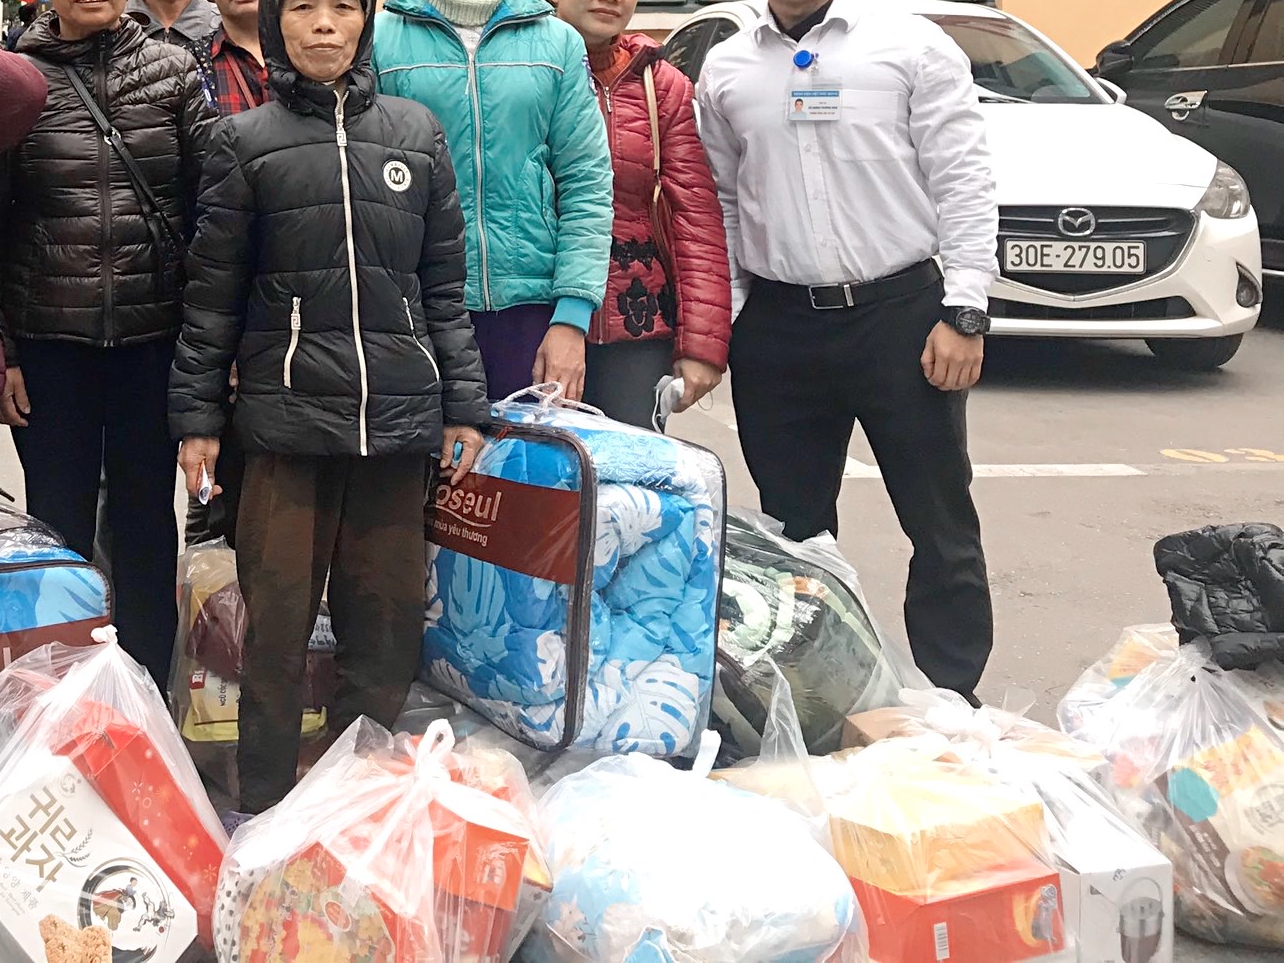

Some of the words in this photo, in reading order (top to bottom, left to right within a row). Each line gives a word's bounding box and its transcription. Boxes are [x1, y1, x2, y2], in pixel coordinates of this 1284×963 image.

[1010, 243, 1141, 270] 30E-279.05
[435, 484, 502, 522] oseul
[28, 785, 78, 852] 귀리
